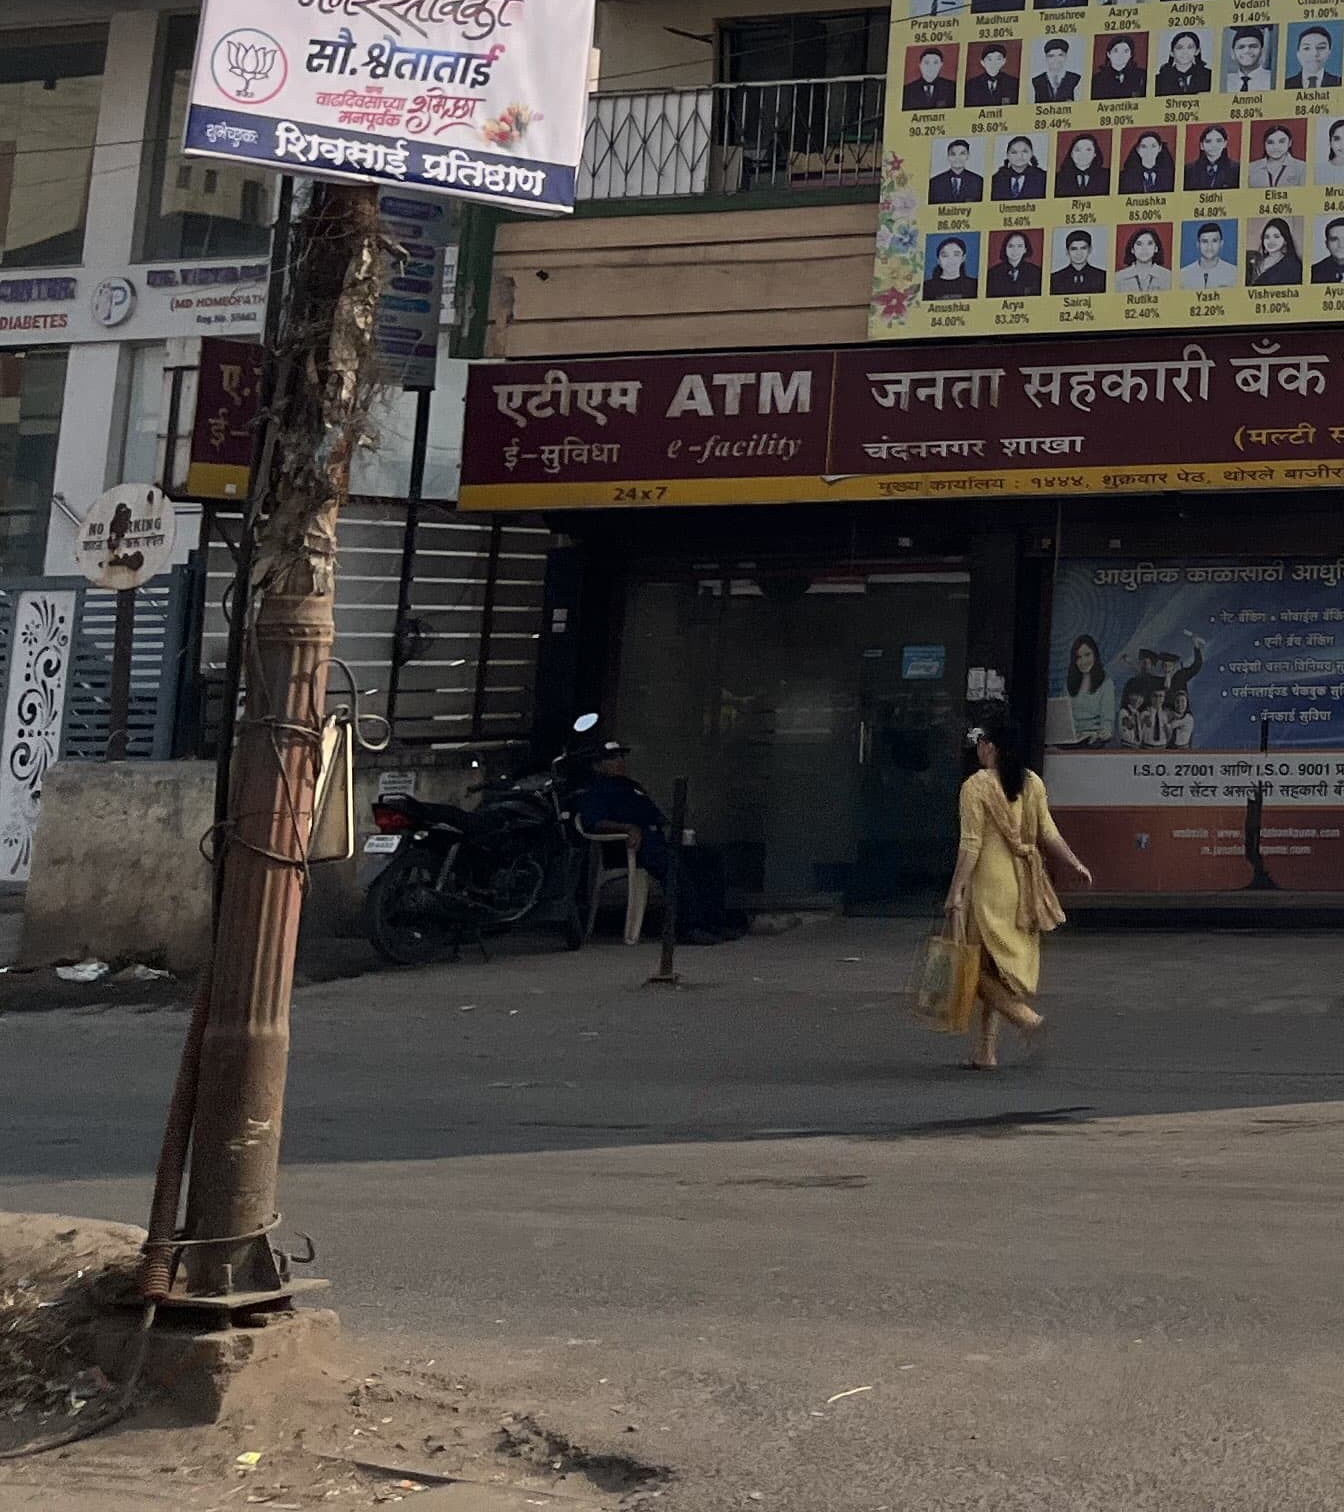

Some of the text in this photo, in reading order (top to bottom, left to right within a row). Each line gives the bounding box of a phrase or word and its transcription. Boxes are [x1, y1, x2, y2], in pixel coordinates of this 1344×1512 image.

[1170, 2, 1204, 15] Aditya
[910, 18, 959, 31] Pratyush
[1168, 15, 1205, 27] 92.00%
[1232, 11, 1271, 23] 91.40%
[1296, 90, 1330, 102] Akshat
[1164, 98, 1200, 111] Shreya
[911, 112, 945, 123] Arman
[273, 120, 409, 182] शिवसाई
[1125, 196, 1166, 208] Anushka
[1247, 288, 1300, 300] Vishvesha
[0, 313, 68, 330] DIABETES
[866, 368, 1006, 412] जनता
[1019, 343, 1216, 412] सहकारी
[1230, 337, 1329, 399] बँक
[492, 369, 642, 429] एटीएम
[665, 370, 812, 419] ATM
[1233, 422, 1318, 453] (मल्टी
[503, 437, 621, 475] ई-सुविधा
[862, 435, 1086, 461] चंदननगर शाखा
[930, 474, 1005, 491] कार्यालय
[1101, 470, 1168, 489] शुक्रवार
[1223, 465, 1275, 482] थोरले
[88, 522, 104, 537] NO
[1094, 563, 1180, 590] आधुनिक
[1174, 764, 1215, 776] 27001
[1219, 761, 1252, 777] आणि
[1298, 763, 1330, 776] 9001
[1160, 781, 1184, 797] डेटा
[1279, 781, 1329, 798] सहकारी
